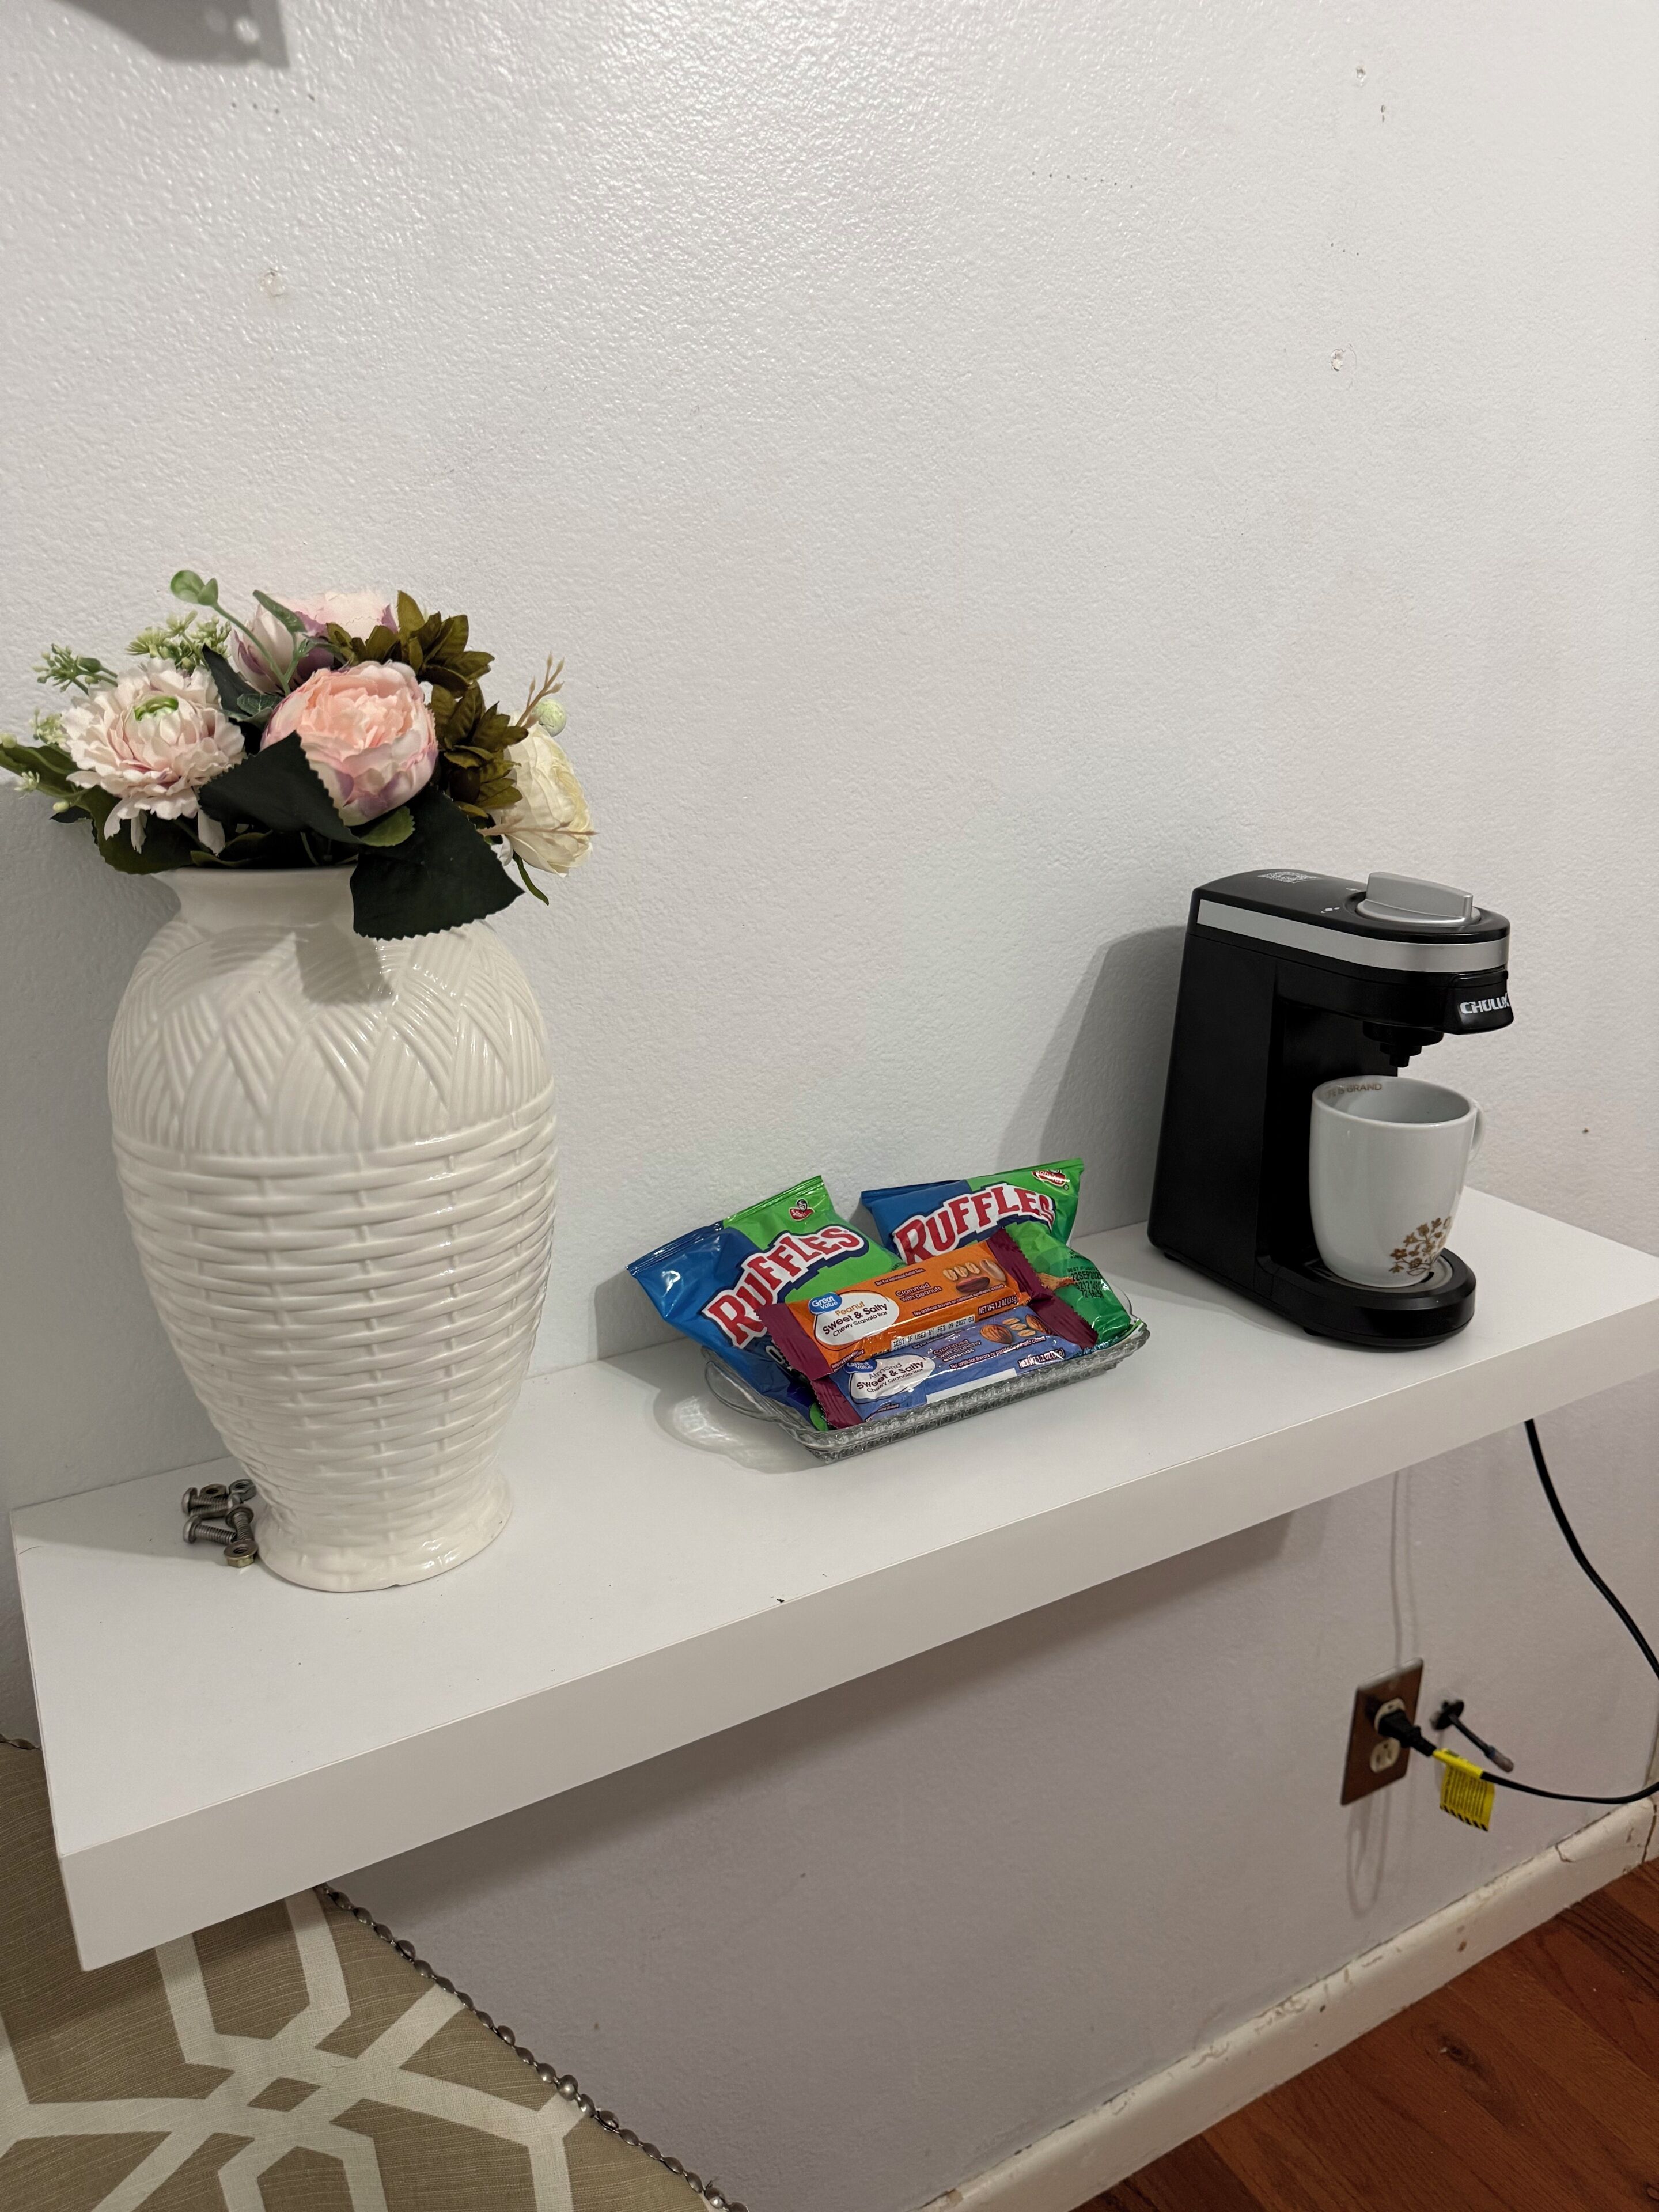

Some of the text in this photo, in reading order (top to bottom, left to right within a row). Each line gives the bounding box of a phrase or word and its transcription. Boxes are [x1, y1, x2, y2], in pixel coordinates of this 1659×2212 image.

[1460, 992, 1510, 1014] CHULUX
[1347, 1083, 1382, 1093] GRAND
[707, 1228, 860, 1345] RUFFLES
[896, 1283, 930, 1297] Crammed
[915, 1286, 942, 1299] peanuts
[812, 1295, 835, 1307] Great
[819, 1301, 838, 1309] Value
[835, 1301, 865, 1316] Peanut
[979, 1306, 987, 1314] NET
[823, 1303, 888, 1335] Sweet & Salty
[833, 1324, 853, 1336] Chewy
[853, 1315, 877, 1325] Granola
[956, 1318, 967, 1327] 2027
[934, 1339, 969, 1354] Crammed
[939, 1349, 953, 1358] with
[953, 1340, 981, 1353] crunchy
[943, 1349, 975, 1361] almonds
[958, 1358, 976, 1366] artificial
[857, 1373, 887, 1389] Sweet
[899, 1361, 924, 1373] Salty
[869, 1362, 903, 1379] Almond
[867, 1382, 887, 1392] Chewy
[888, 1373, 912, 1383] Granola
